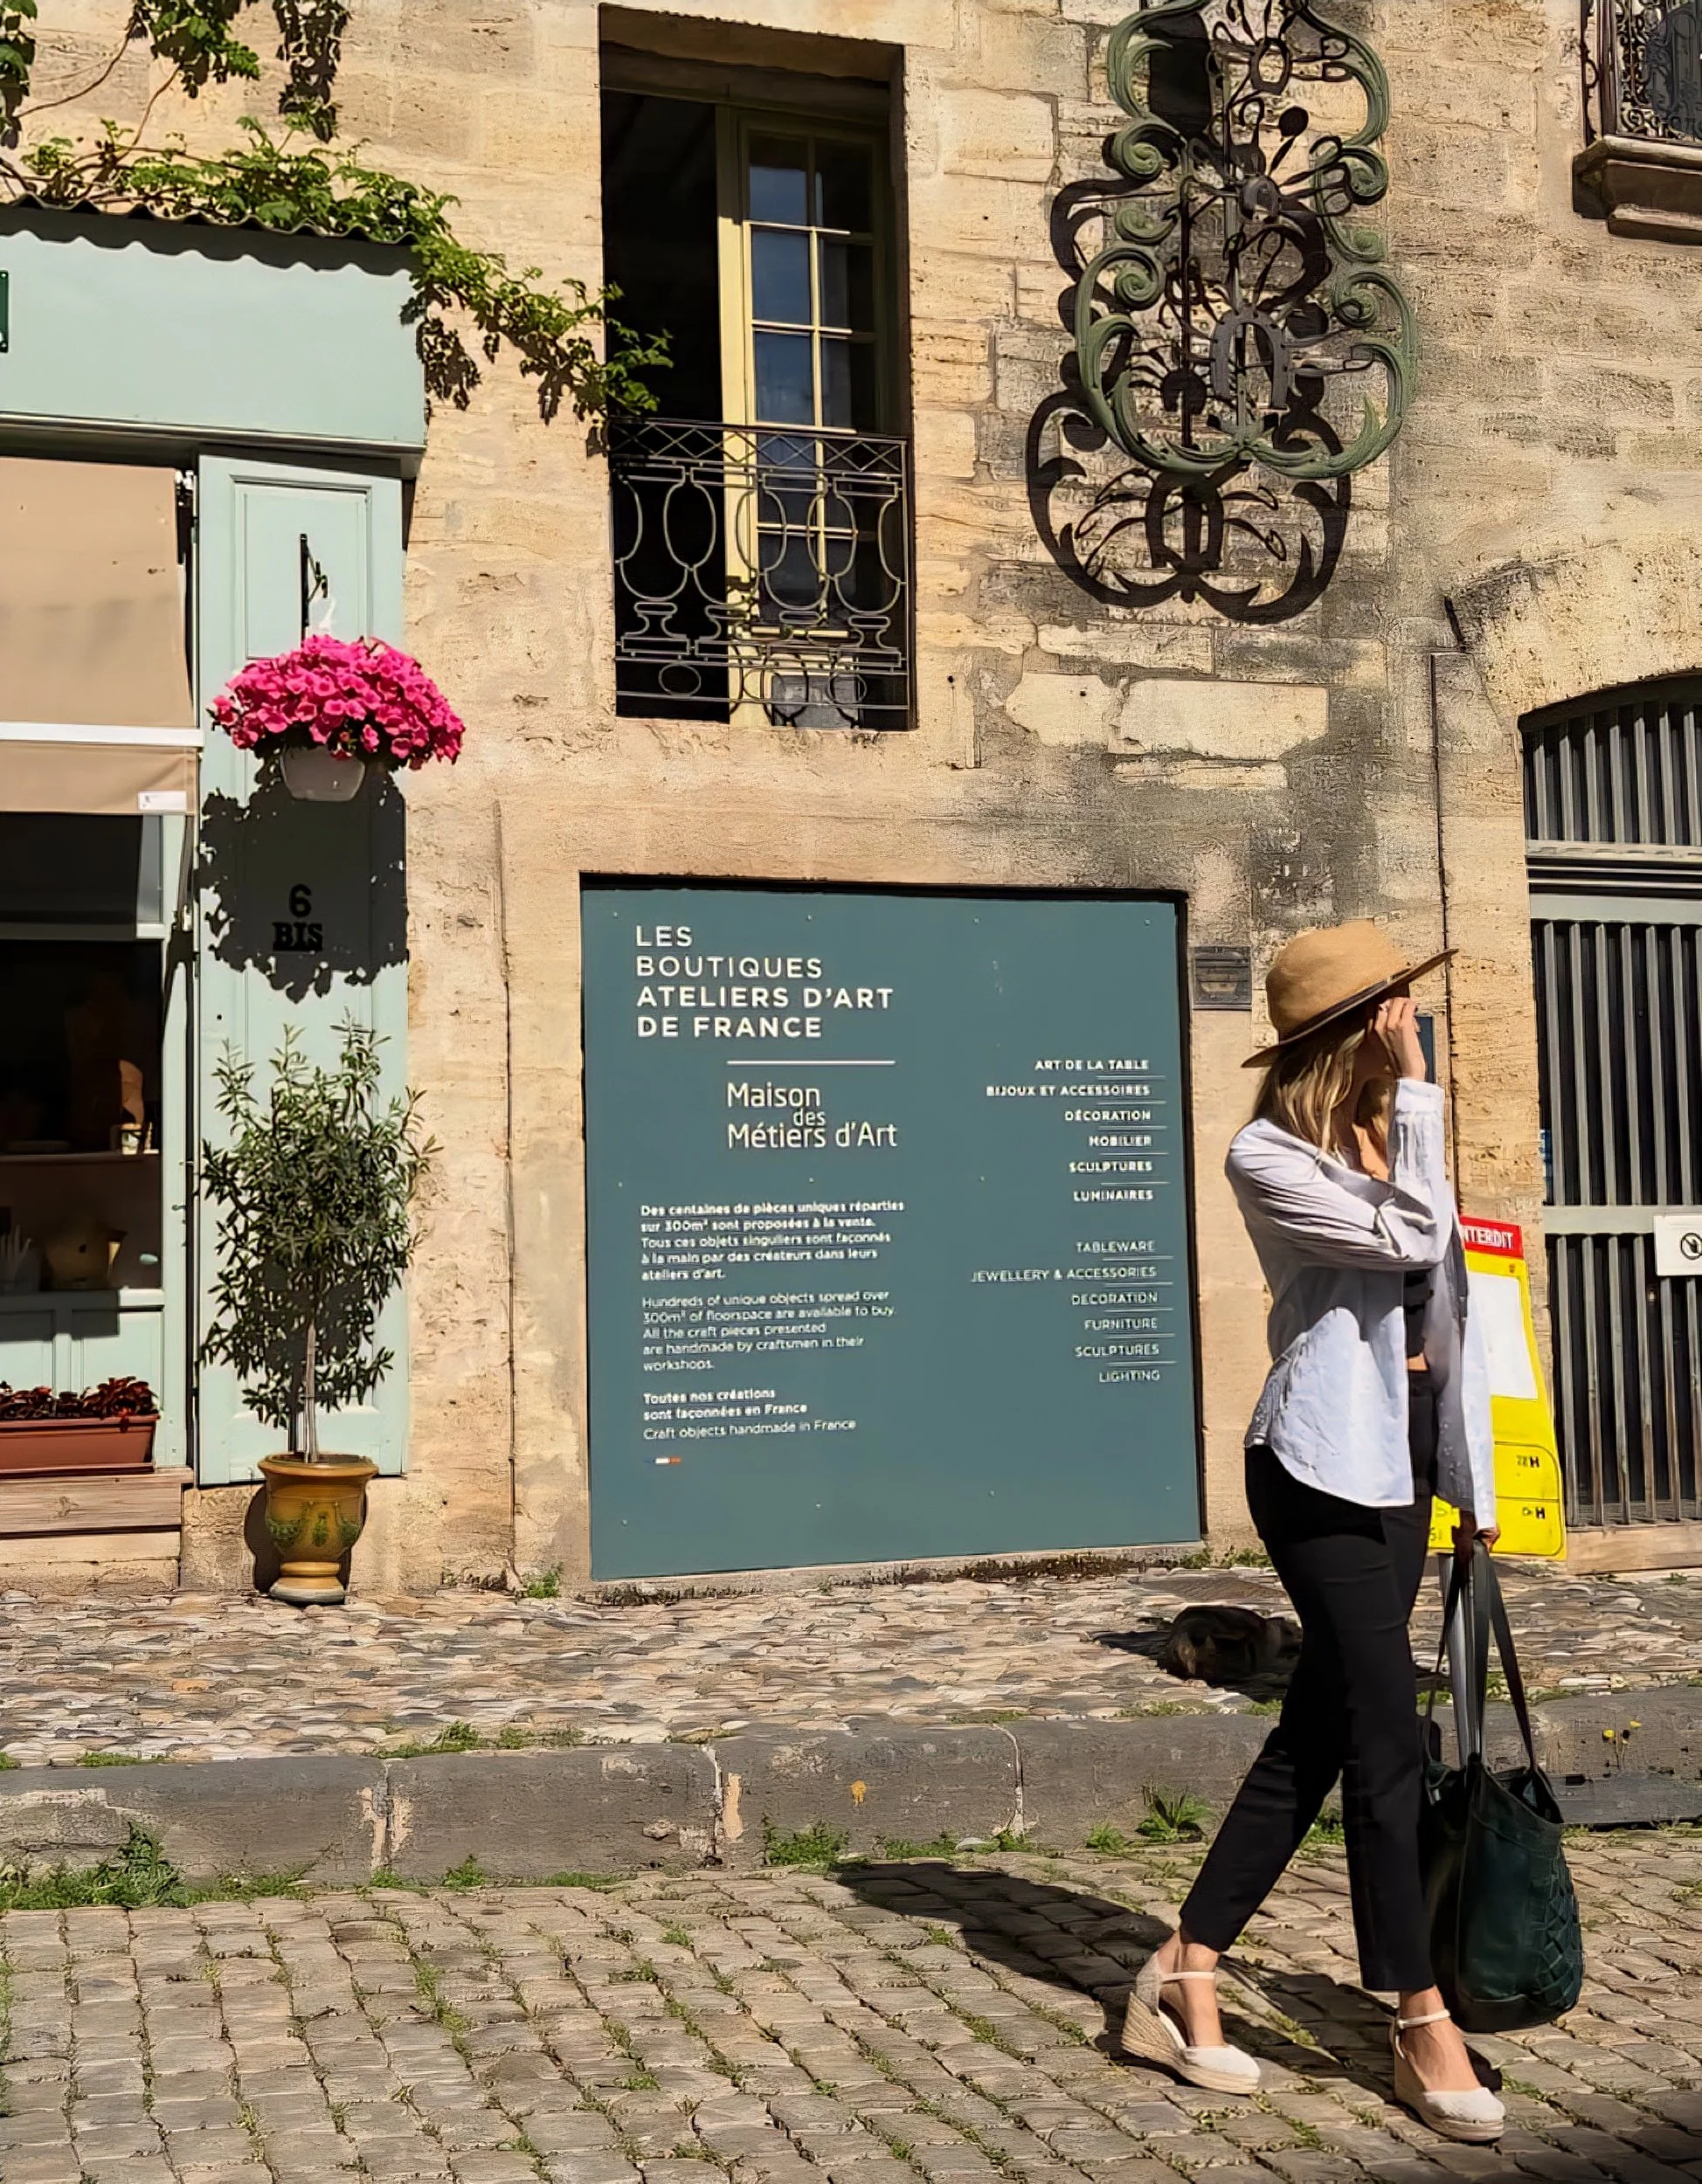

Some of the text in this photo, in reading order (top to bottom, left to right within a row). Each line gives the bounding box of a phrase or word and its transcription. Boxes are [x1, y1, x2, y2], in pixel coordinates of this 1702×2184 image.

[289, 883, 312, 918] 6
[272, 922, 323, 951] BIS
[635, 925, 694, 947] LES
[635, 956, 822, 979] BOUTIQUES
[636, 986, 893, 1009] ATELIERS D'ART
[637, 1017, 821, 1038] DE FRANCE
[1034, 1060, 1149, 1070] ART DE LA TABLE
[727, 1082, 821, 1109] Maison
[986, 1085, 1150, 1096] BIJOUX ET ACCESSOIRES
[792, 1108, 826, 1127] des
[1065, 1109, 1151, 1121] DÉCORATION
[727, 1123, 897, 1149] Métiers d'Art
[1090, 1136, 1152, 1146] MOBILIER
[1069, 1161, 1152, 1172] SCULPTURES
[1074, 1190, 1153, 1202] LUMINAIRES
[641, 1200, 904, 1216] Des centaines de pièces uniques réparties
[641, 1222, 660, 1232] sur
[712, 1220, 739, 1230] sont
[744, 1219, 809, 1229] proposées
[813, 1217, 820, 1227] à
[823, 1216, 834, 1227] la
[641, 1232, 890, 1248] Tous ces objets singuliers sont façonnés
[1076, 1241, 1156, 1253] TABLEWARE
[641, 1248, 877, 1264] à la main par des créateurs dans leurs
[641, 1270, 688, 1281] ateliers
[971, 1267, 1157, 1282] JEWELLERY & ACCESSORIES
[642, 1291, 889, 1308] Hundreds of unique objects spread over
[1071, 1292, 1158, 1305] DECORATION
[689, 1310, 702, 1321] of
[707, 1310, 772, 1322] floorspace
[799, 1306, 852, 1317] available
[854, 1306, 868, 1316] to
[643, 1324, 827, 1339] All the craft pieces presented
[1083, 1317, 1158, 1330] FURNITURE
[643, 1336, 864, 1355] are handmade by craftsmen in their
[1075, 1344, 1159, 1357] SCULPTURES
[1099, 1370, 1160, 1383] LIGHTING
[643, 1388, 775, 1404] Toutes nos créations
[643, 1404, 806, 1420] sont façonnées en France
[644, 1419, 856, 1440] Craft objects handmade in France
